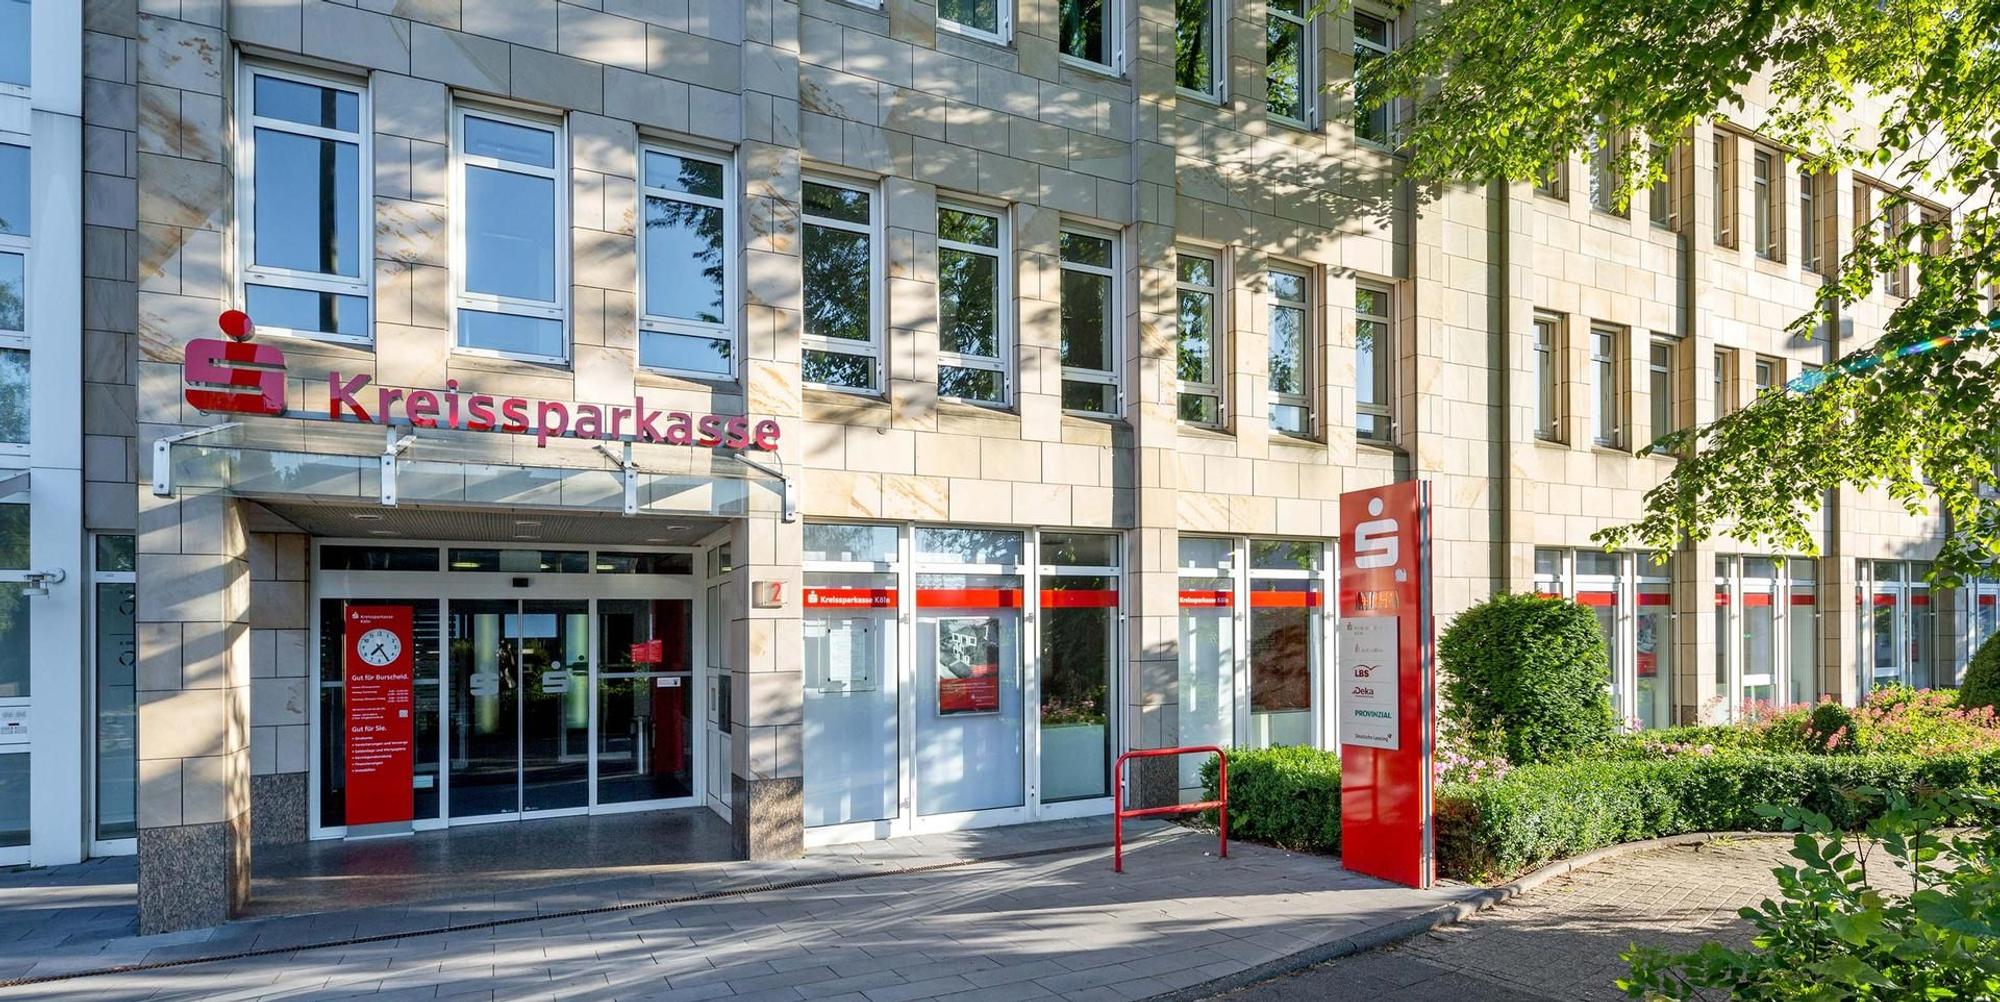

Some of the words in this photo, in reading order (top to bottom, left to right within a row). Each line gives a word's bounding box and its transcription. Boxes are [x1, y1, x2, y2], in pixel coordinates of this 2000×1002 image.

[329, 371, 781, 452] Kreissparkasse
[771, 582, 781, 602] 2
[820, 596, 873, 605] Kreissparkasse
[1354, 669, 1369, 678] LBS
[1352, 686, 1374, 695] Deka
[1354, 709, 1393, 719] PROVINZIAL
